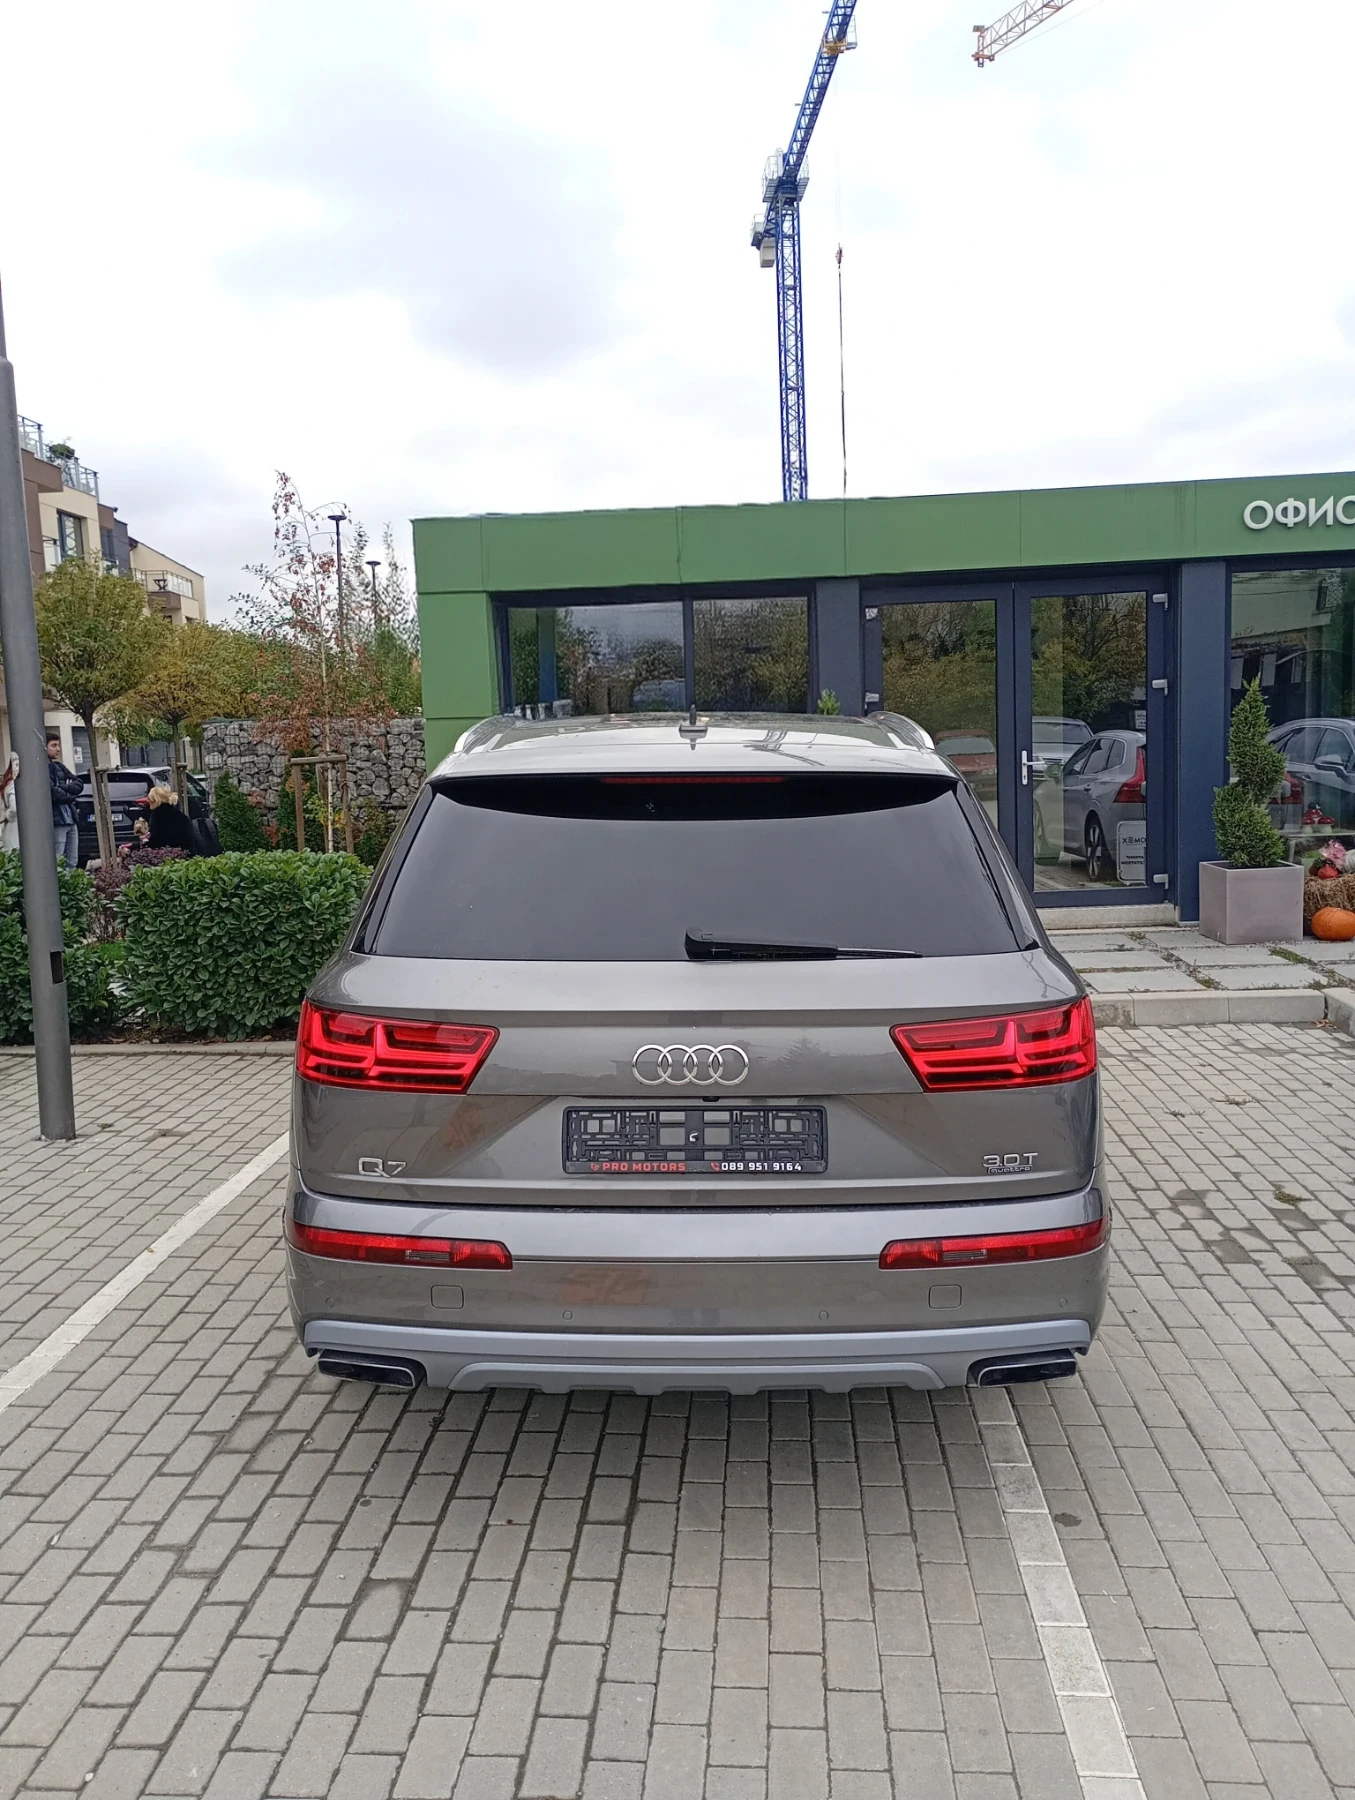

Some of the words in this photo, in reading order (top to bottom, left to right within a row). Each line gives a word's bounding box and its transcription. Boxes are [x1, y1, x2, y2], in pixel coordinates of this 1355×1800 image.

[1243, 495, 1355, 530] ОФИС
[983, 1152, 1038, 1167] 3.0T
[358, 1157, 407, 1178] Q7
[602, 1162, 628, 1171] PRO
[632, 1162, 686, 1171] MOTORS
[721, 1162, 744, 1171] 089
[748, 1162, 768, 1171] 951
[773, 1162, 802, 1171] 9164
[989, 1166, 1031, 1174] quattro
